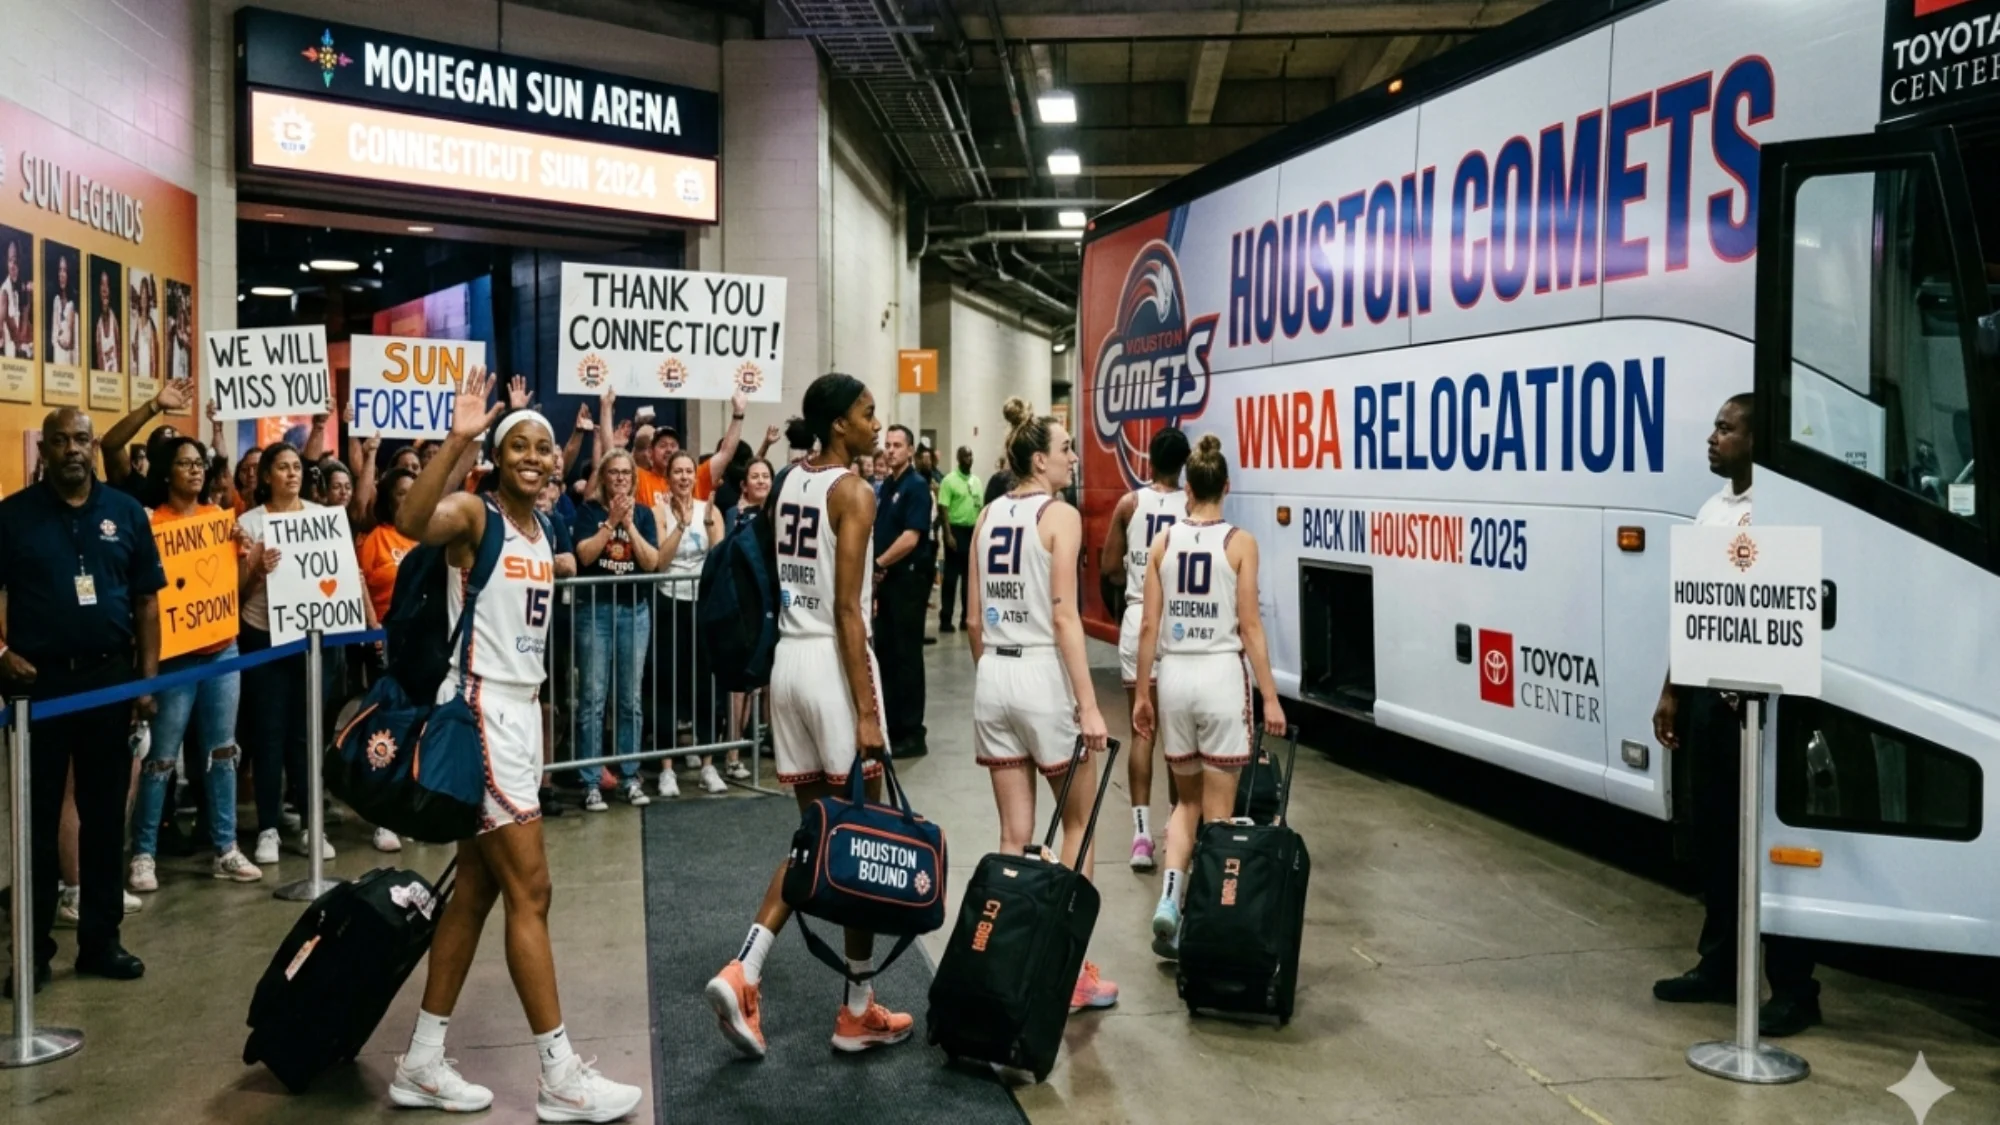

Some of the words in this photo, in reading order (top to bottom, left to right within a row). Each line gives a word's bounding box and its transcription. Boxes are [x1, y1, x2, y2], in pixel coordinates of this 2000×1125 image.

[364, 41, 518, 110] MOHEGAN
[526, 71, 584, 120] SUN
[590, 83, 681, 136] ARENA
[348, 122, 533, 184] CONNECTICUT
[540, 149, 590, 191] SUN
[595, 156, 657, 200] 2024
[20, 150, 63, 215] SUN
[67, 170, 144, 246] LEGENDS
[1228, 165, 1437, 348] HOUSTON
[1450, 54, 1776, 310] COMETS
[583, 272, 689, 312] THANK
[704, 278, 765, 317] YOU
[209, 335, 253, 368] WE
[262, 332, 324, 366] WILL
[569, 314, 781, 361] CONNECTICUT!
[382, 342, 465, 385] SUN
[912, 363, 922, 388] 1
[1096, 330, 1211, 437] COMETS
[214, 373, 276, 411] MISS
[281, 369, 331, 408] YOU!
[354, 388, 457, 431] FOREVE
[1235, 388, 1342, 470] WNBA
[1354, 356, 1666, 474] RELOCATION
[269, 513, 342, 544] THANK
[777, 502, 821, 560] 32
[1303, 507, 1344, 552] BACK
[1349, 510, 1366, 554] IN
[1371, 511, 1464, 564] HOUSTON!
[1470, 517, 1528, 571] 2025
[294, 549, 338, 579] YOU
[987, 526, 1024, 575] 21
[986, 581, 1025, 600] MABREY
[1177, 551, 1213, 595] 10
[166, 589, 236, 634] T-SPOON!
[272, 597, 363, 633] T-SPOON
[526, 586, 550, 628] 15
[1001, 610, 1029, 624] AT&T
[1674, 581, 1746, 607] HOUSTON
[1750, 584, 1817, 611] COMETS
[1686, 613, 1763, 645] OFFICIAL
[1767, 619, 1804, 647] BUS
[1520, 645, 1600, 688] TOYOTA
[1520, 681, 1601, 724] CENTER
[850, 836, 918, 870] HOUSTON
[858, 860, 908, 890] BOUND
